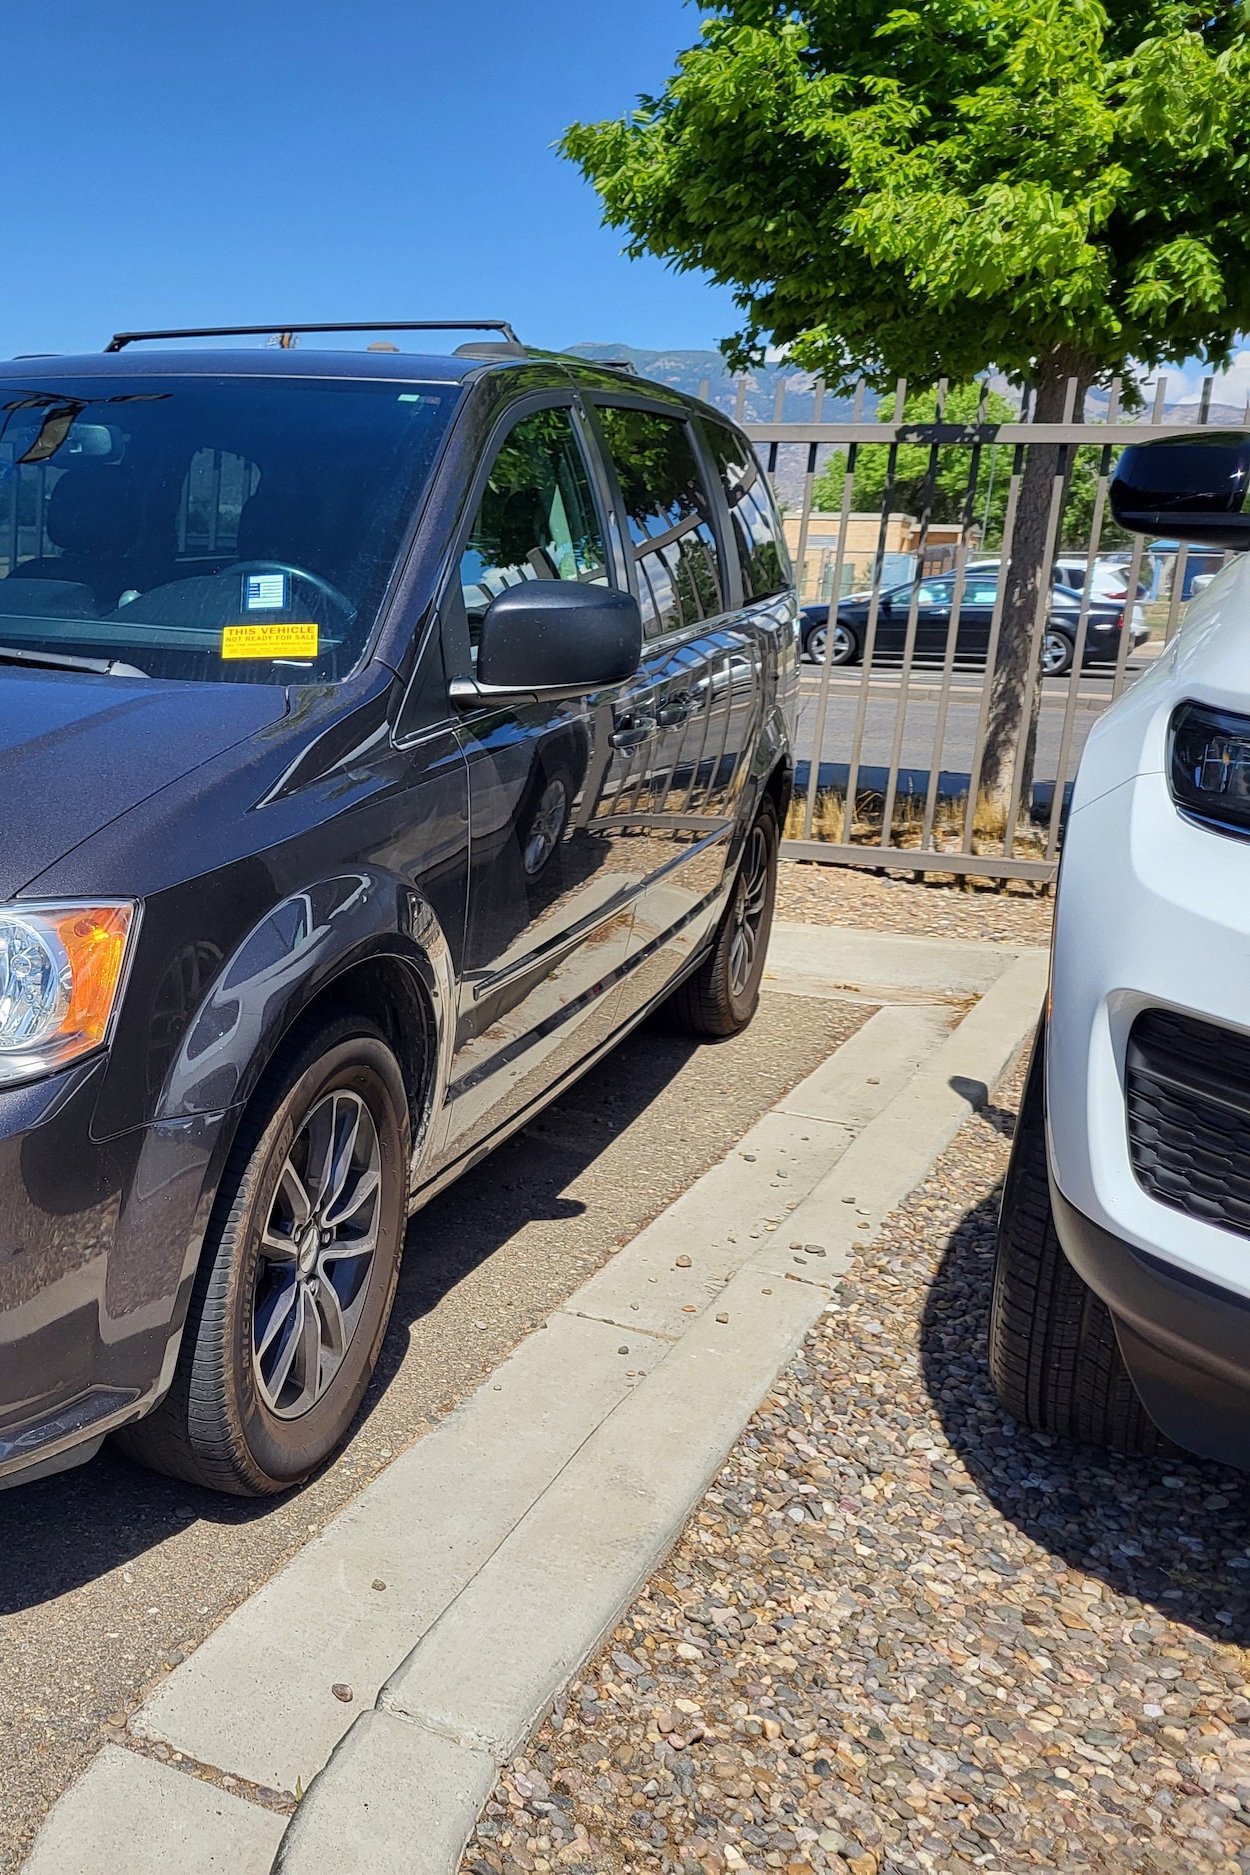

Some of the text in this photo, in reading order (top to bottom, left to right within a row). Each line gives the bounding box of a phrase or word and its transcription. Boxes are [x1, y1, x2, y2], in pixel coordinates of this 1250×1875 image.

[228, 626, 315, 636] THIS VEHICLE
[241, 1237, 261, 1369] MICHELIN
